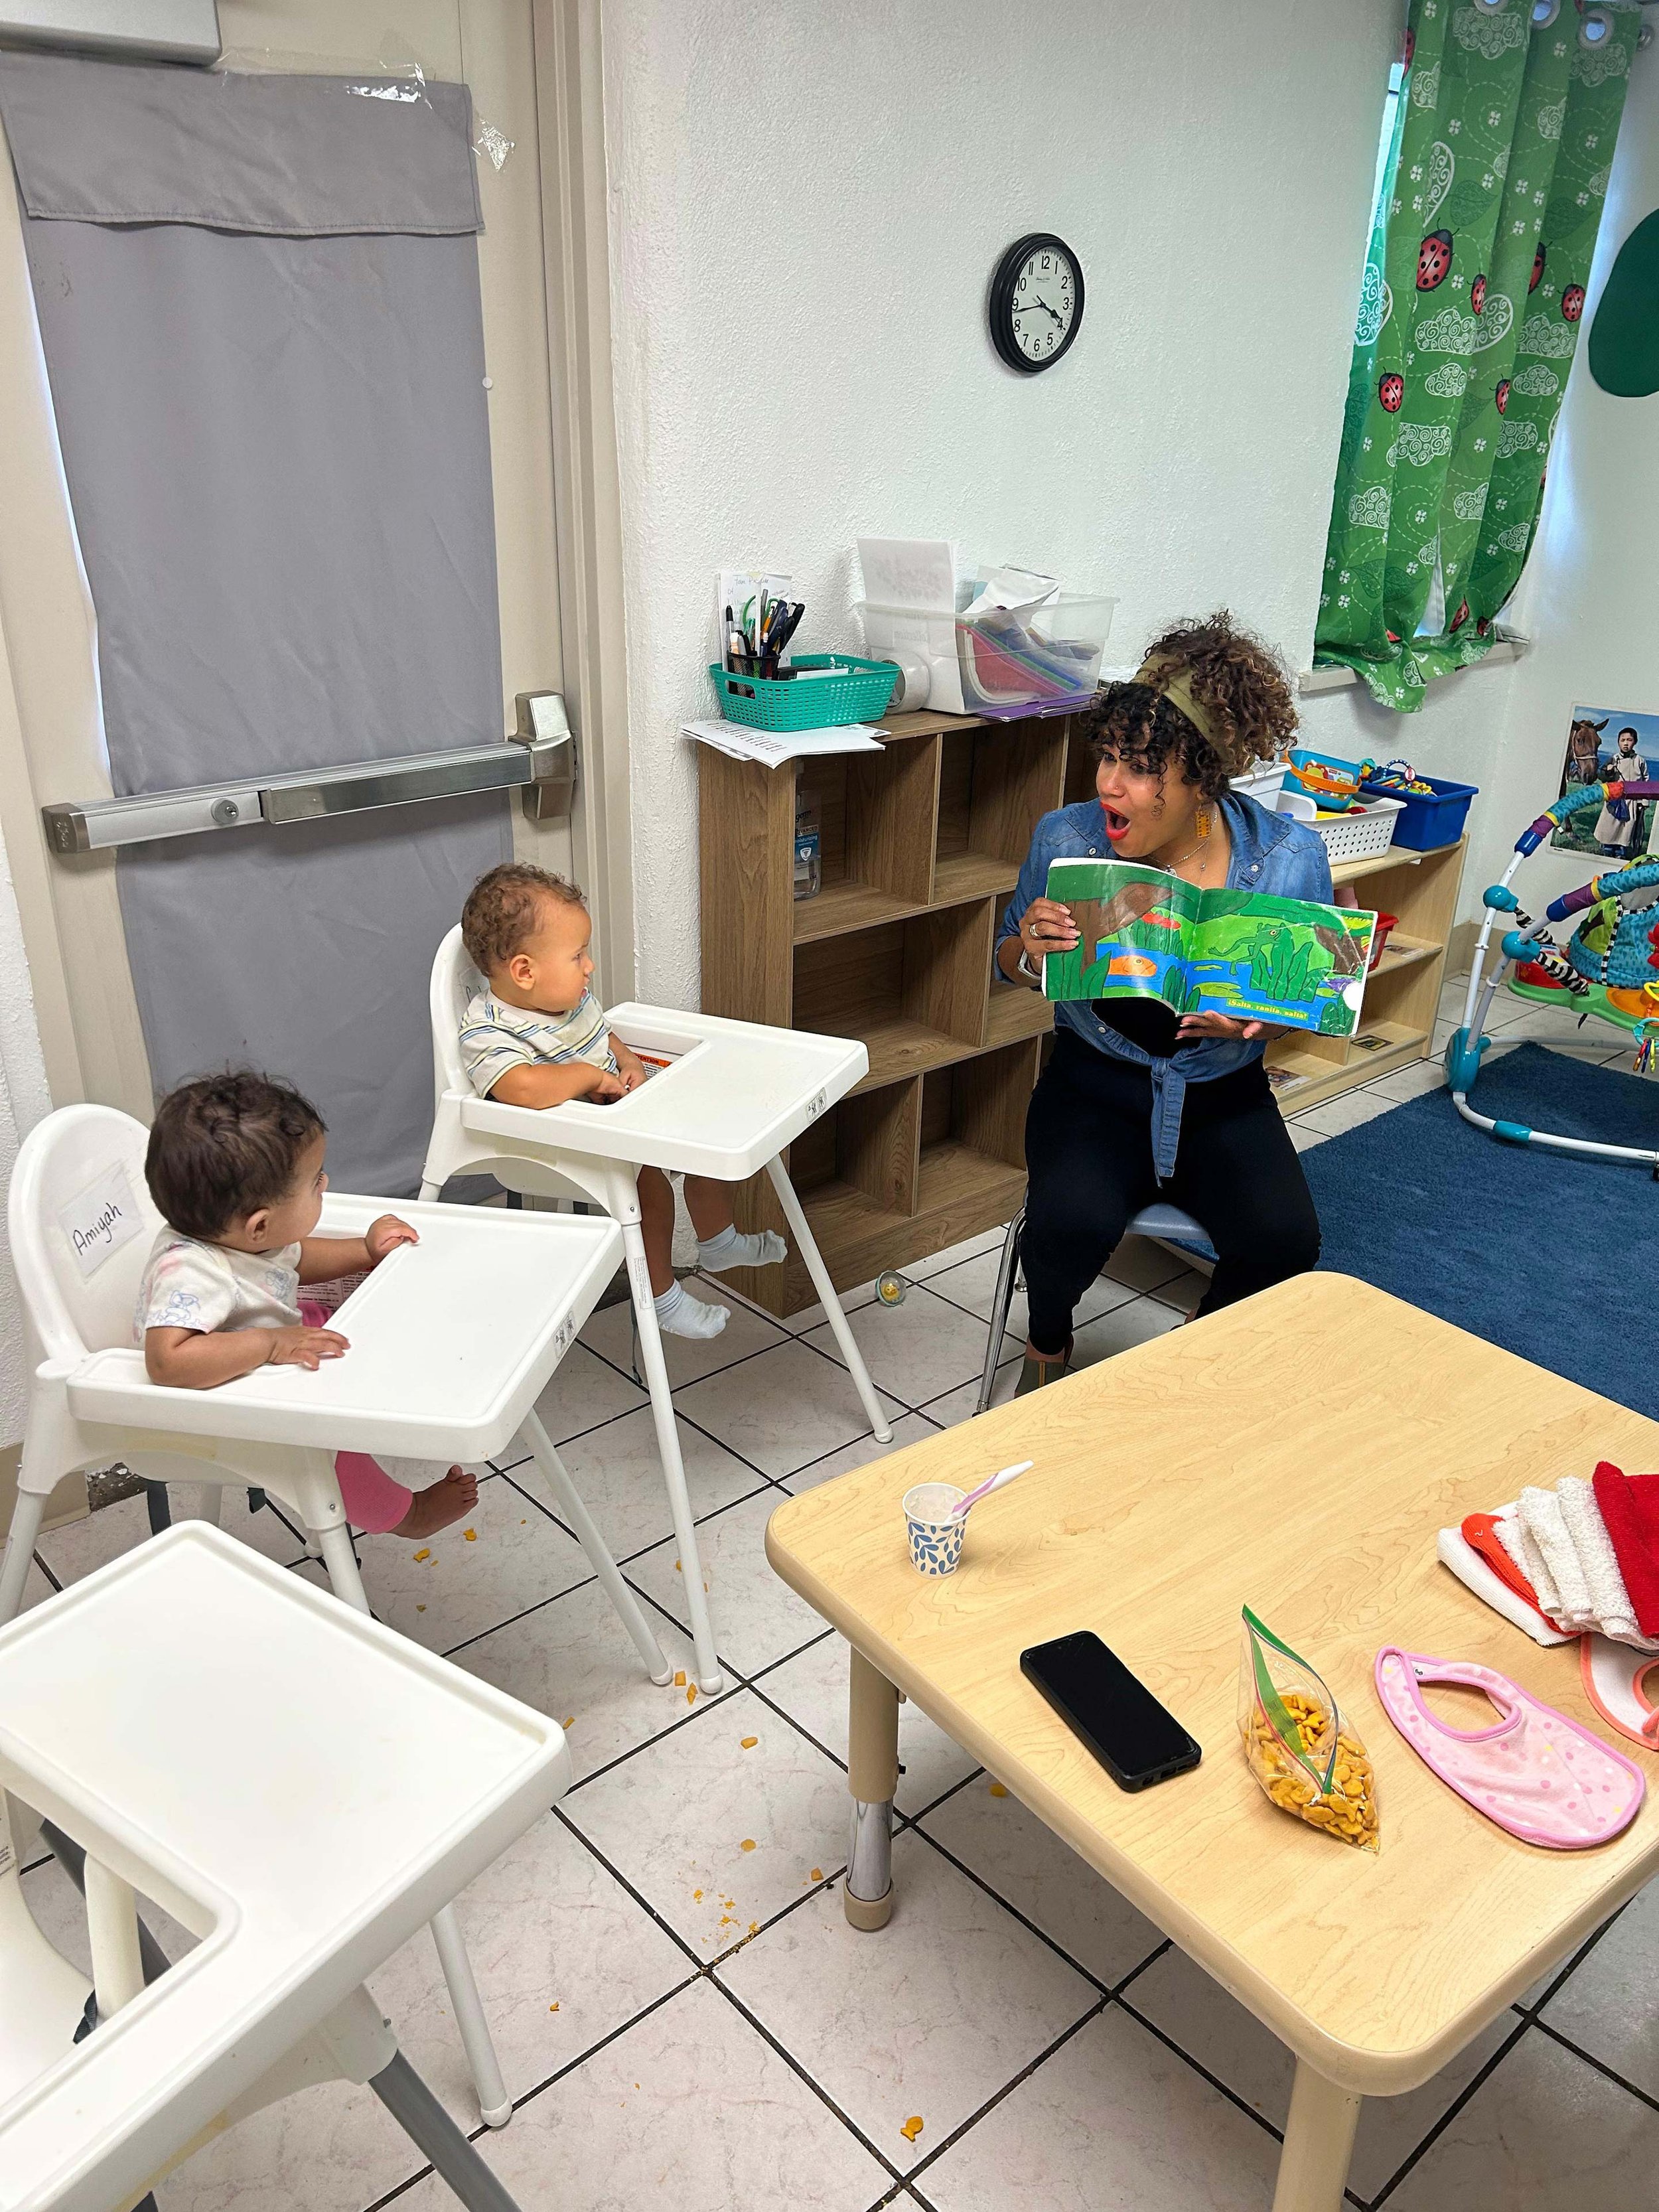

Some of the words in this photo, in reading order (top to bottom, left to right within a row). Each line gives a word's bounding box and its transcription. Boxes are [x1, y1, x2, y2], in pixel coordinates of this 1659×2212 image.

[1029, 261, 1034, 275] 11
[1041, 256, 1050, 269] 12
[1054, 261, 1058, 274] 1
[1017, 277, 1027, 291] 10
[1061, 276, 1068, 289] 2
[1012, 298, 1019, 311] 9
[1062, 297, 1069, 311] 3
[1014, 319, 1021, 332] 8
[1023, 334, 1029, 347] 7
[1034, 338, 1040, 352] 6
[1046, 332, 1054, 346] 5
[72, 1203, 122, 1256] Amiyah
